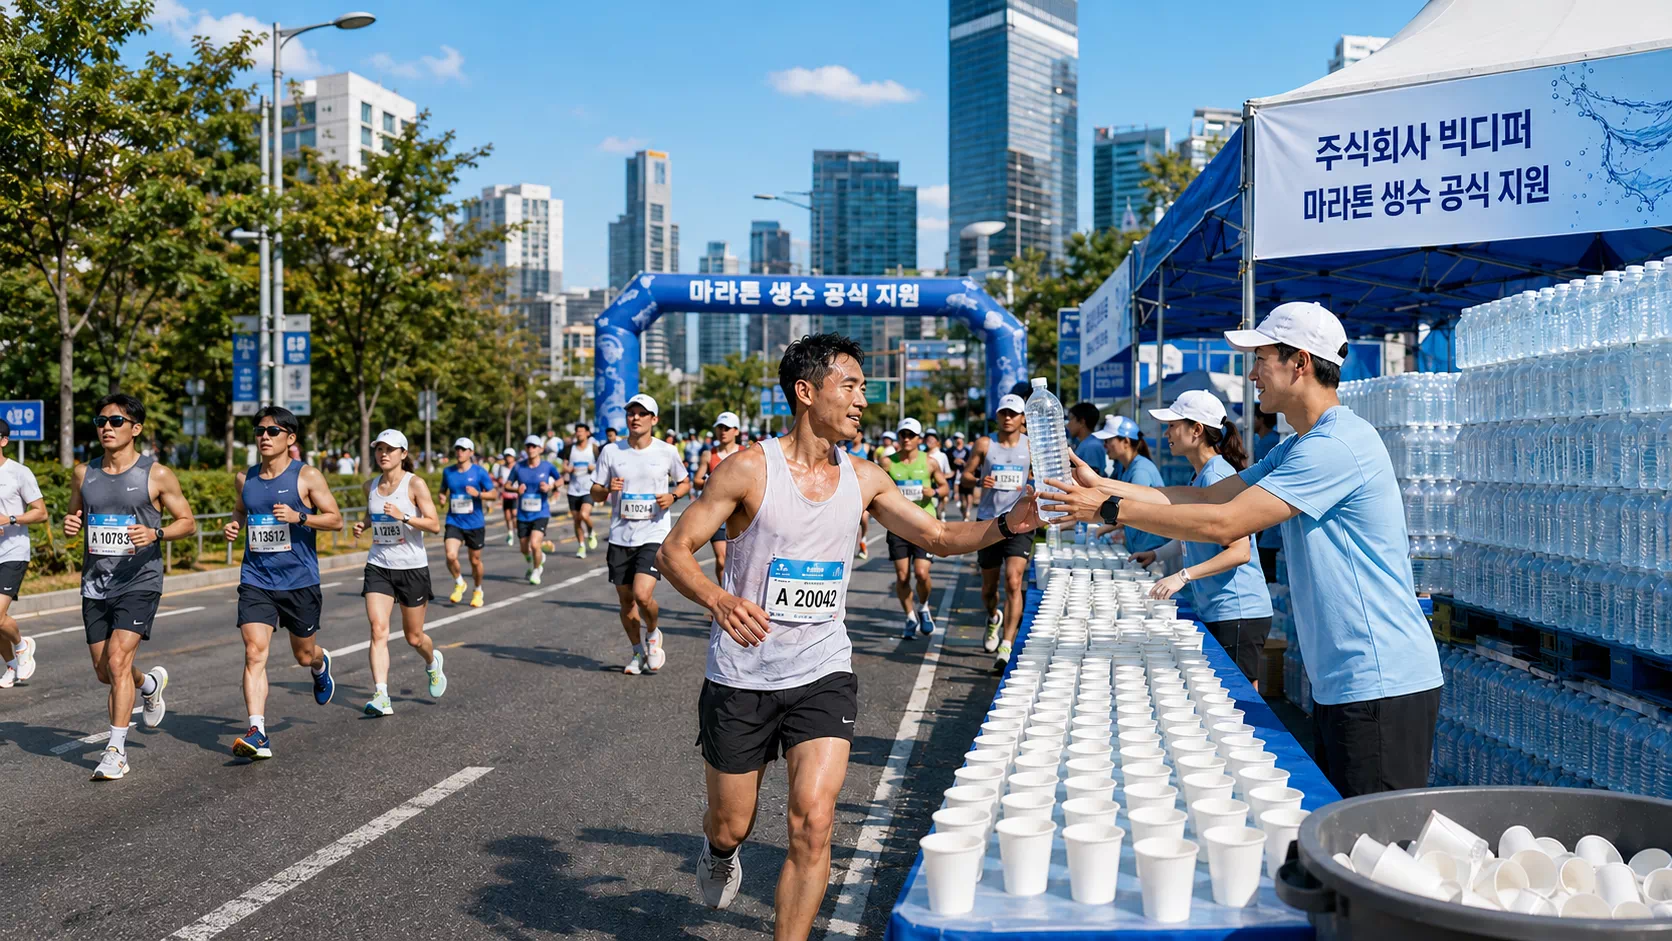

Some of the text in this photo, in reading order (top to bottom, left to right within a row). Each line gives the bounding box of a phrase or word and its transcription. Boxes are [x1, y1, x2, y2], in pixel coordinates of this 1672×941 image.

[1315, 108, 1532, 171] 주식회사 빅디퍼
[1303, 164, 1550, 224] 마라톤 생수 공식 지원
[689, 279, 920, 308] 마라톤 생수 공식 지원
[91, 531, 130, 545] A 10783
[251, 529, 286, 543] A 13512
[775, 587, 837, 608] A 20042
